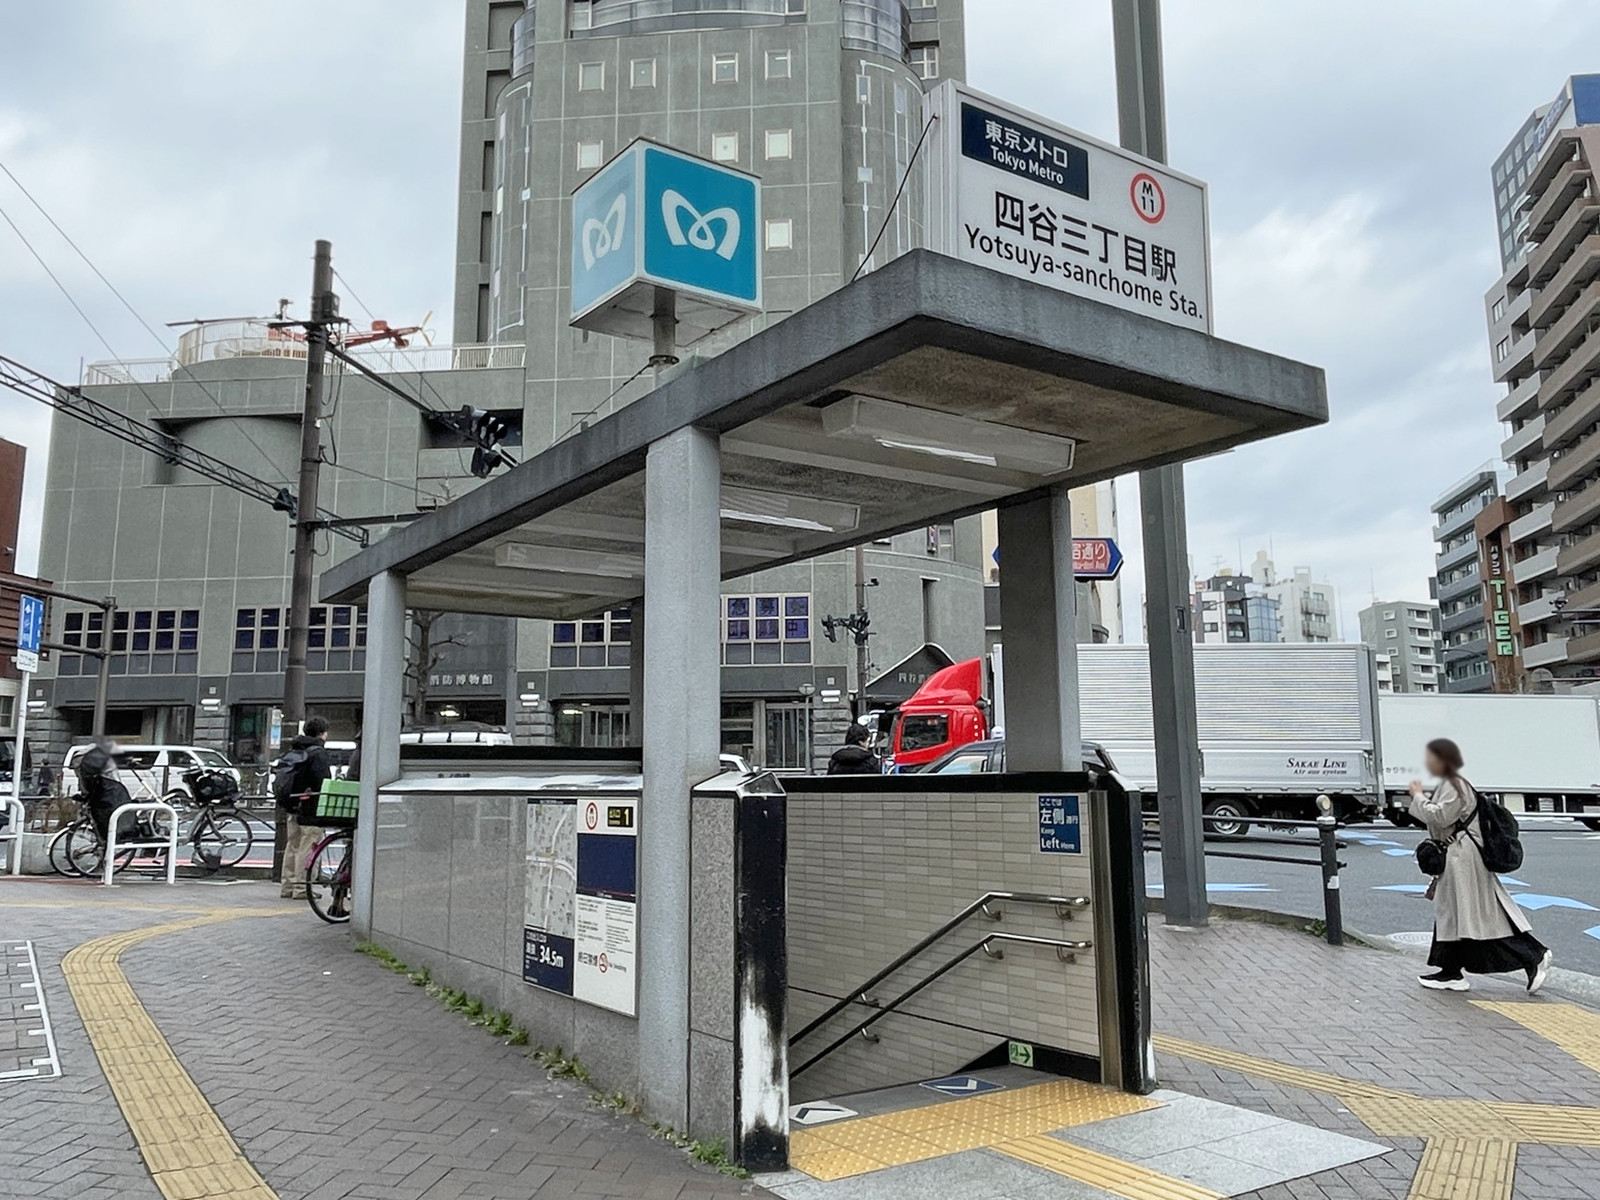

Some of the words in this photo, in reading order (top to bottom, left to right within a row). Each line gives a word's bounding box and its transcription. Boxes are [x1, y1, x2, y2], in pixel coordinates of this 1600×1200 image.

[984, 118, 1069, 169] 東京メトロ
[990, 145, 1027, 172] Tokyo
[1028, 157, 1065, 185] Metro
[1141, 181, 1154, 195] M
[1141, 195, 1156, 214] 11
[994, 190, 1179, 286] 四谷三丁目駅
[964, 223, 1164, 307] Yotsuya-sanchome
[1168, 289, 1204, 319] Sta.
[1490, 580, 1513, 655] TIGER
[624, 808, 630, 826] 1
[1041, 837, 1060, 849] Left
[539, 945, 564, 968] 34.5m
